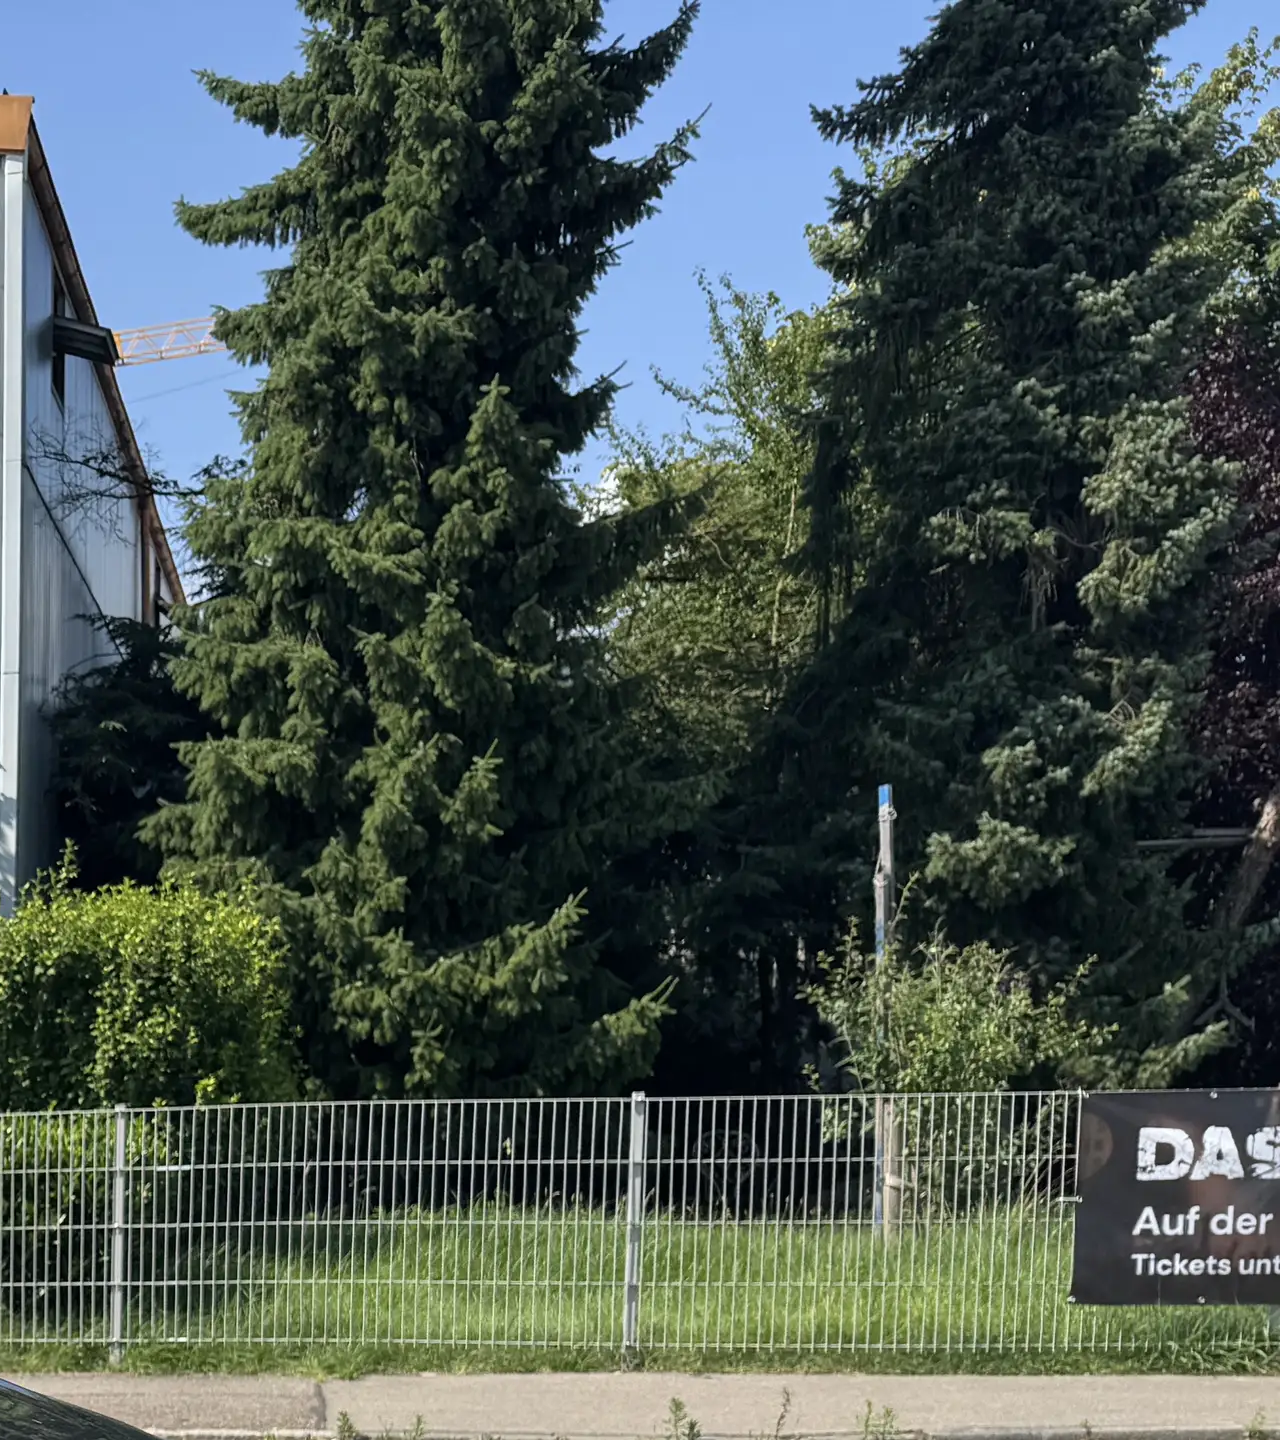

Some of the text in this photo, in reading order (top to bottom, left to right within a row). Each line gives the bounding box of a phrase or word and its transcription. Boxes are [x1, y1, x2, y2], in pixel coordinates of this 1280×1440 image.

[1136, 1124, 1280, 1181] DAS
[1131, 1205, 1273, 1236] Auf der
[1130, 1253, 1231, 1276] Tickets
